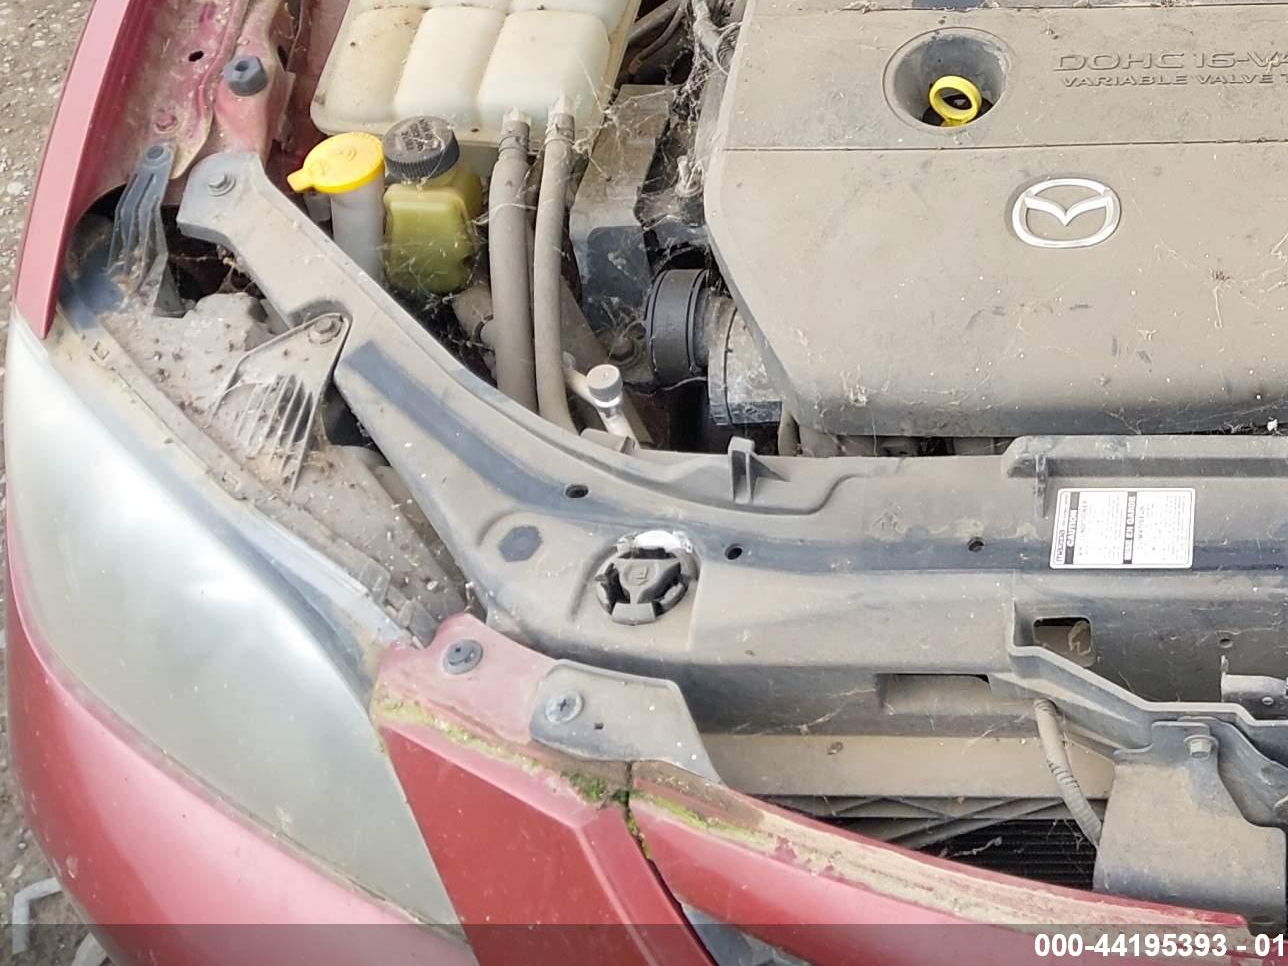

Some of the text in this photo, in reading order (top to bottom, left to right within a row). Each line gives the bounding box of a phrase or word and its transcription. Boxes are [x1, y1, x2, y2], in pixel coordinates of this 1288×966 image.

[1053, 52, 1185, 72] DOHC
[1062, 74, 1188, 87] VARIABLE
[1197, 72, 1274, 85] VALVE
[1066, 508, 1077, 547] CAUTION
